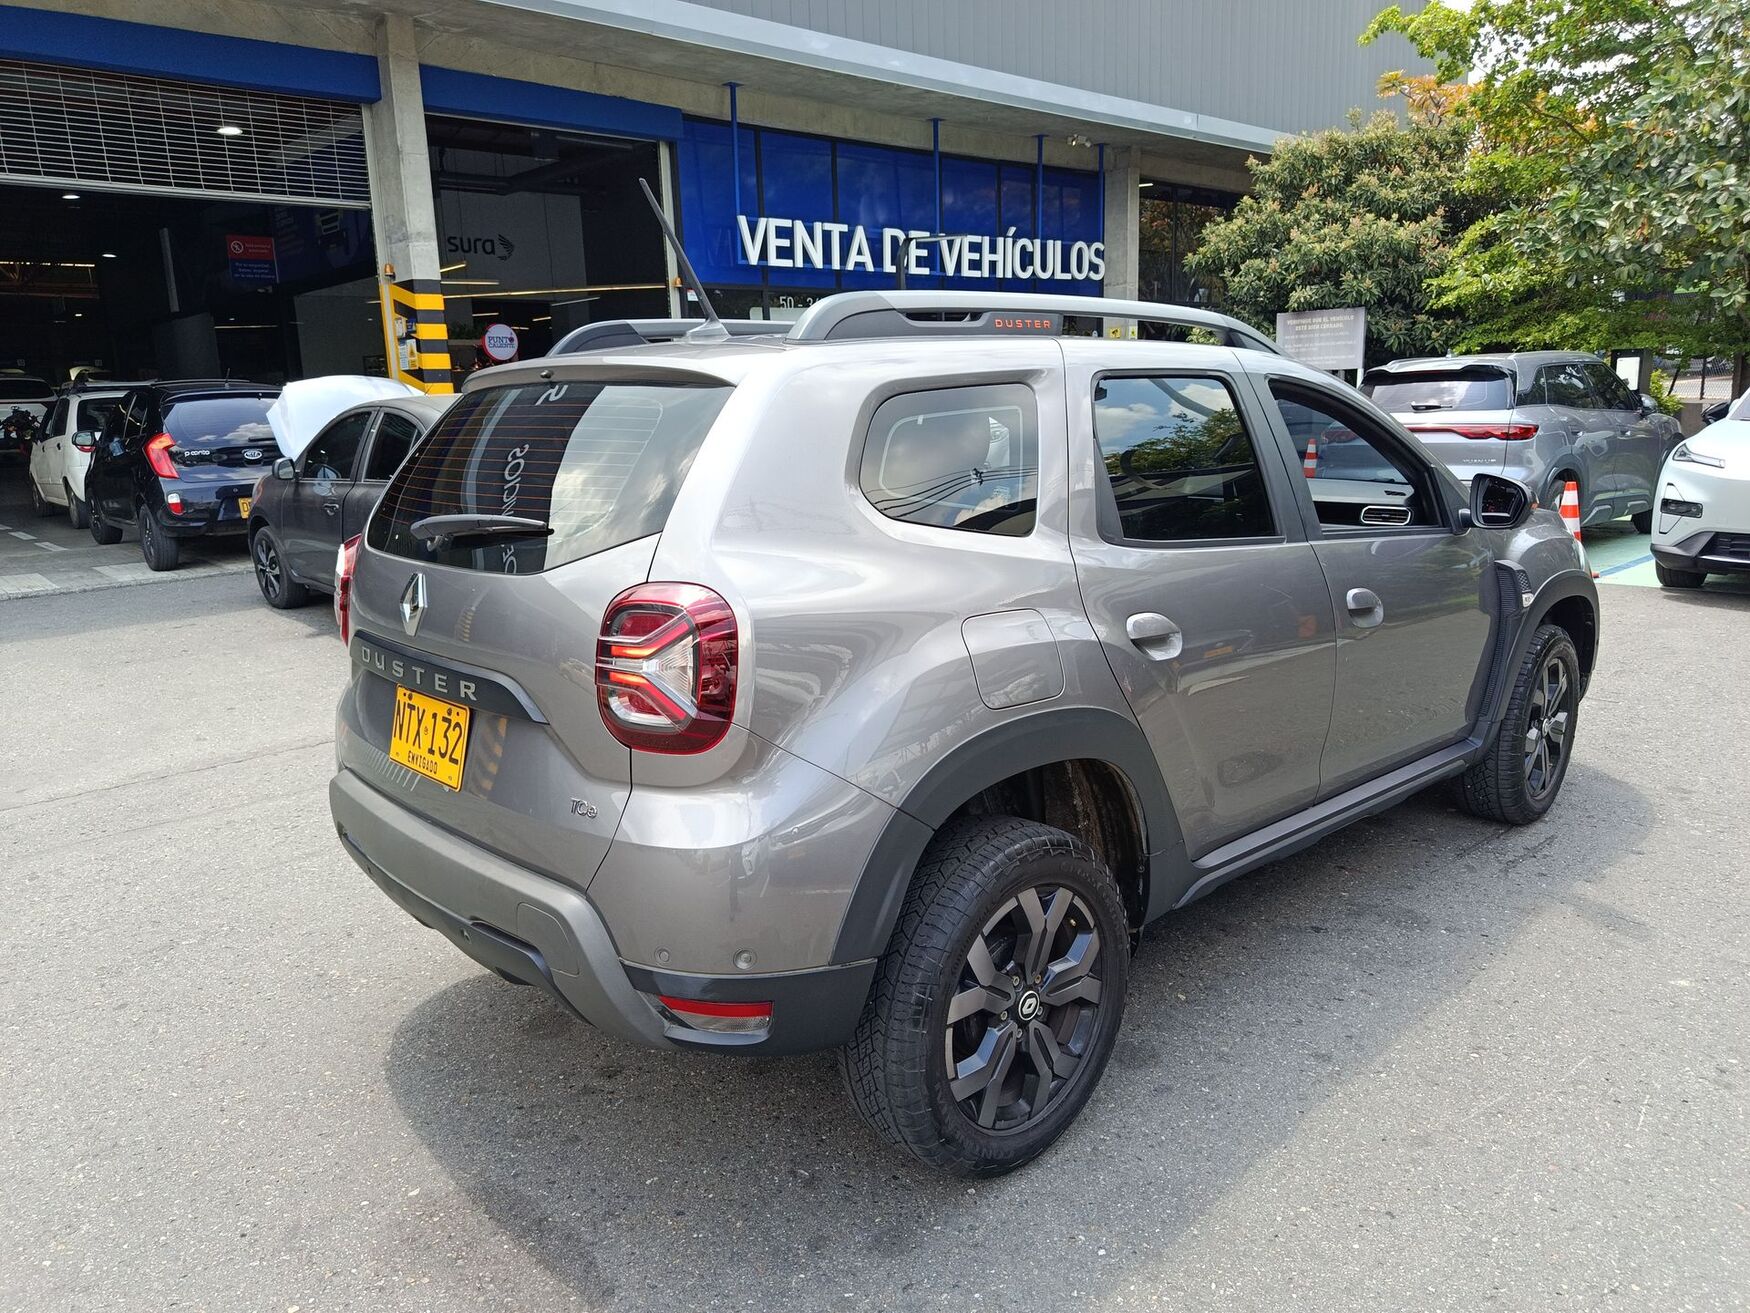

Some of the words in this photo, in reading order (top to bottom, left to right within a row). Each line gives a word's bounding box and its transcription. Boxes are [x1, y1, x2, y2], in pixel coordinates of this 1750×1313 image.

[447, 236, 496, 255] sura
[737, 215, 875, 272] VENTA
[882, 227, 930, 275] DE
[938, 226, 1106, 281] VEHÍCULOS
[995, 319, 1052, 329] DUSTER
[361, 645, 478, 701] DUSTER
[393, 698, 428, 751] NTX
[427, 711, 464, 766] 132
[407, 750, 438, 775] ENVIGADO
[570, 798, 597, 819] TCe
